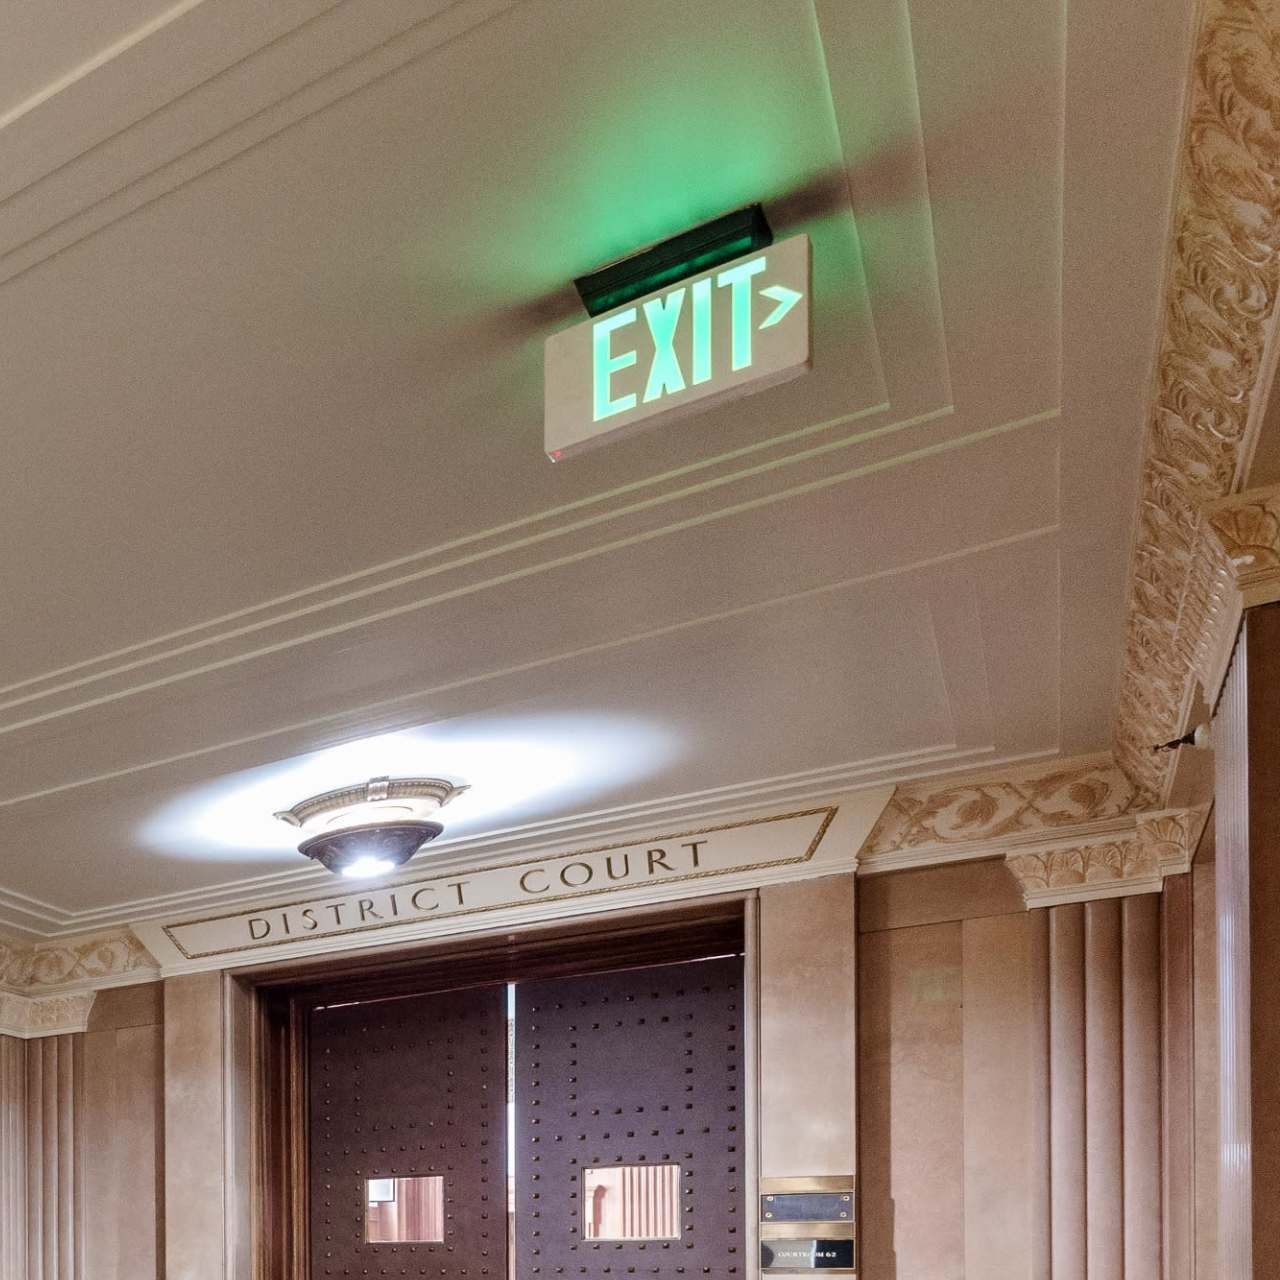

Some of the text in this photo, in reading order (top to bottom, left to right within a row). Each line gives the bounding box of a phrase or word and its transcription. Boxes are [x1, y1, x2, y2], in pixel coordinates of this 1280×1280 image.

[592, 255, 767, 422] EXIT
[248, 840, 708, 940] DISTRICT COURT
